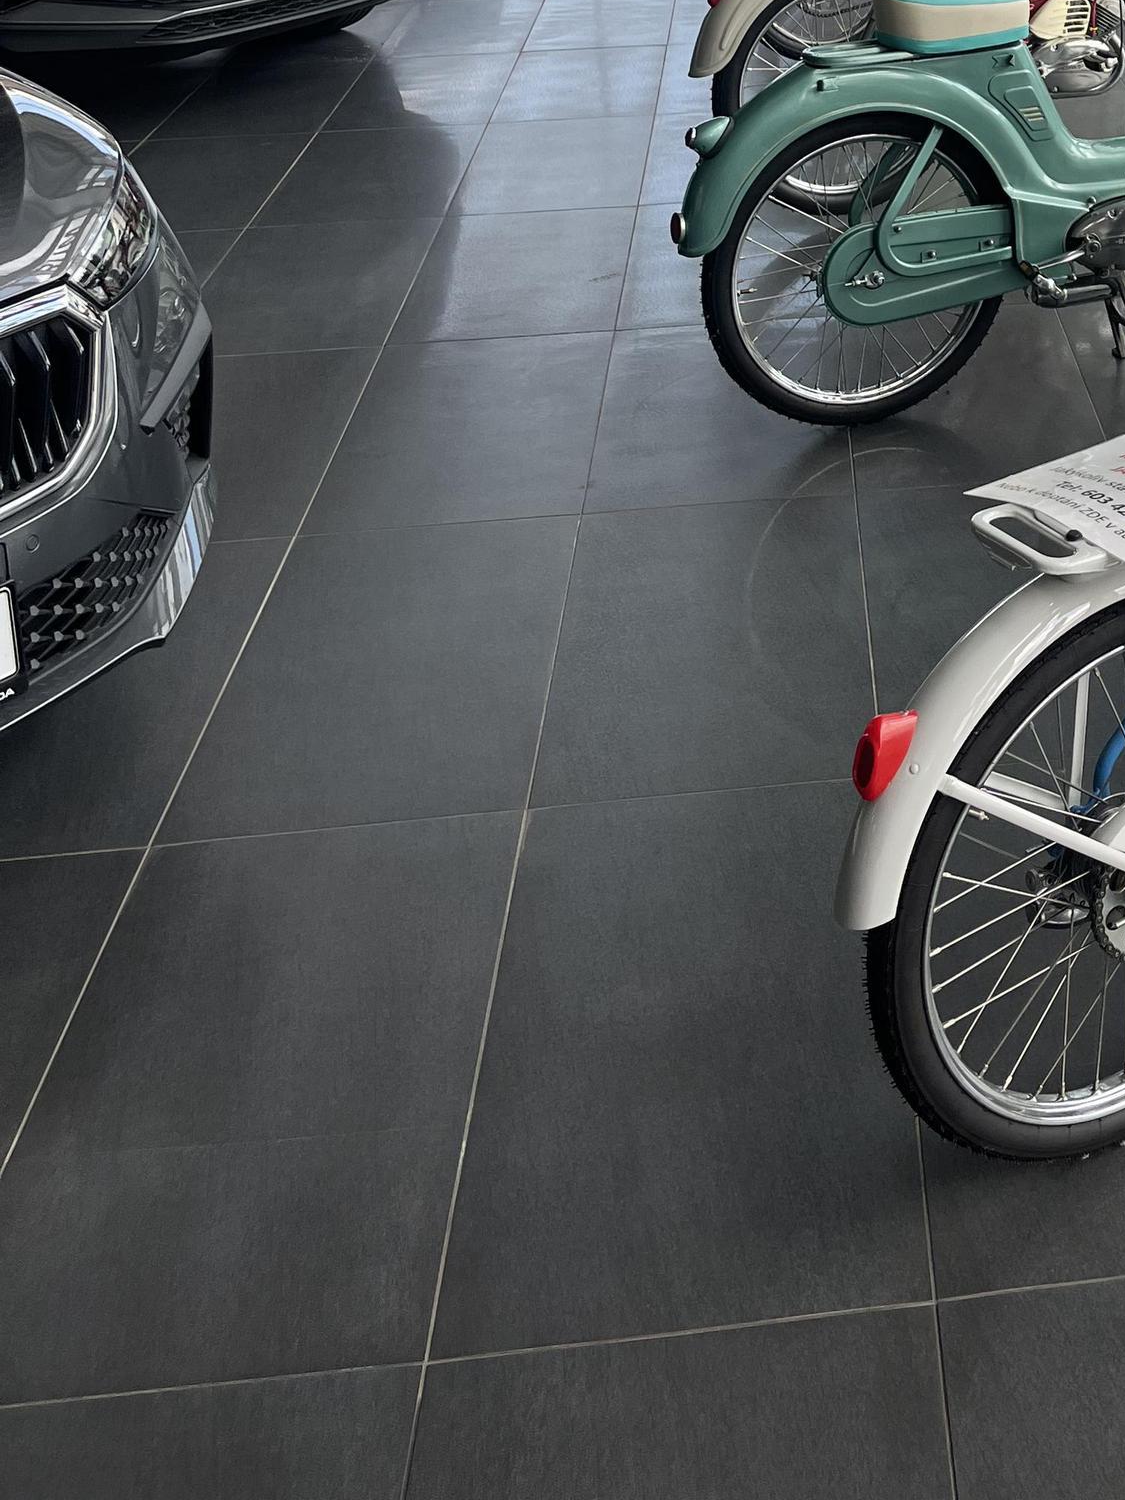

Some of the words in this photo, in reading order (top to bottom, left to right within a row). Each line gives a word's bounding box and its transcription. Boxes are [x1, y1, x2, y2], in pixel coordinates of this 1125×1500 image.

[1056, 481, 1083, 493] Tel:
[1081, 489, 1114, 504] 603
[1079, 507, 1110, 524] ZDE
